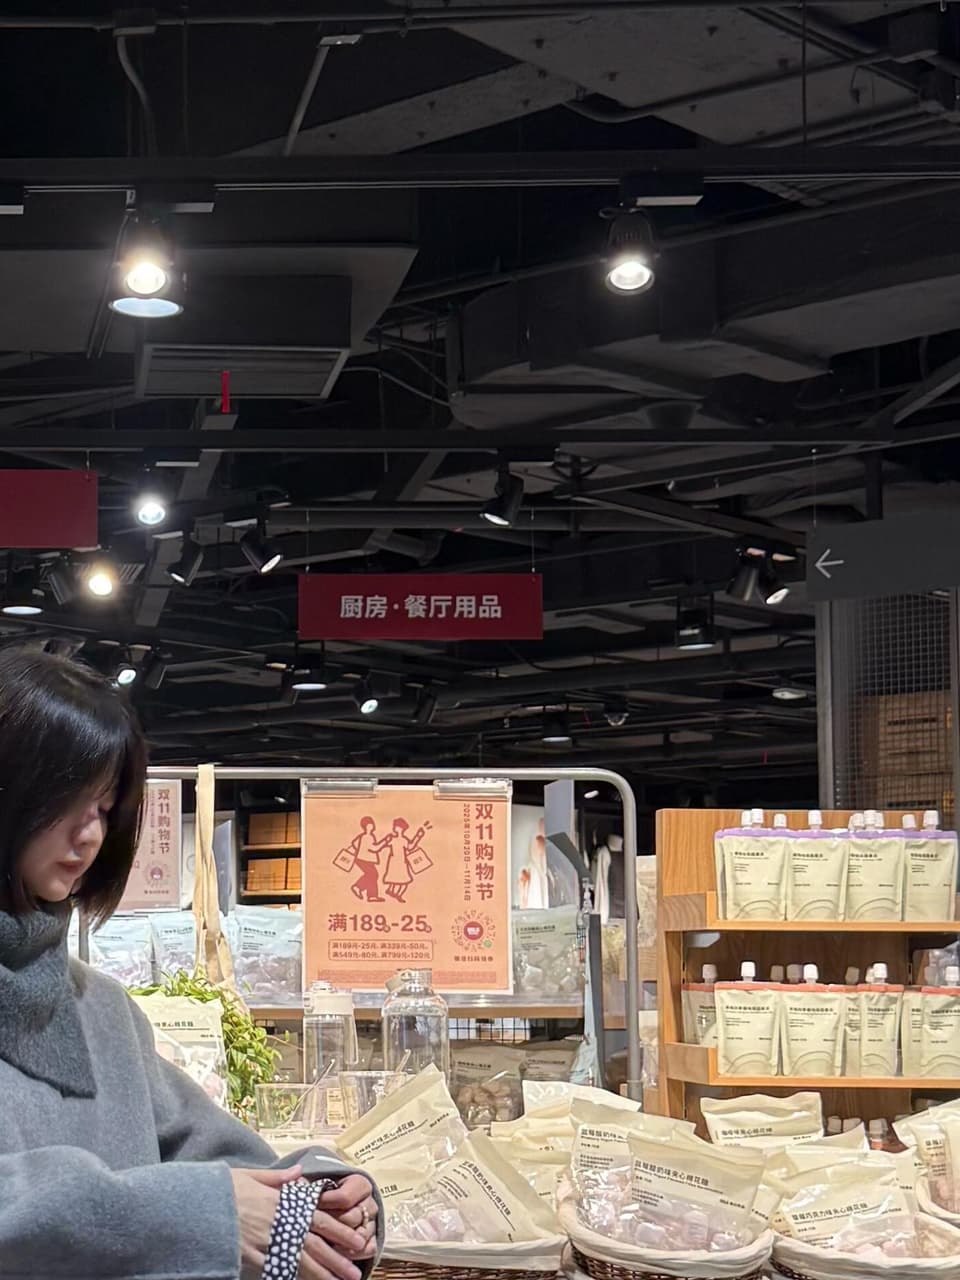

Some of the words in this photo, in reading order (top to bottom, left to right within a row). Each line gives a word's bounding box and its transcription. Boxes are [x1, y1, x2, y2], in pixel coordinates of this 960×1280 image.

[340, 595, 502, 619] 厨房·餐厅用品
[475, 803, 494, 901] 双11购物节
